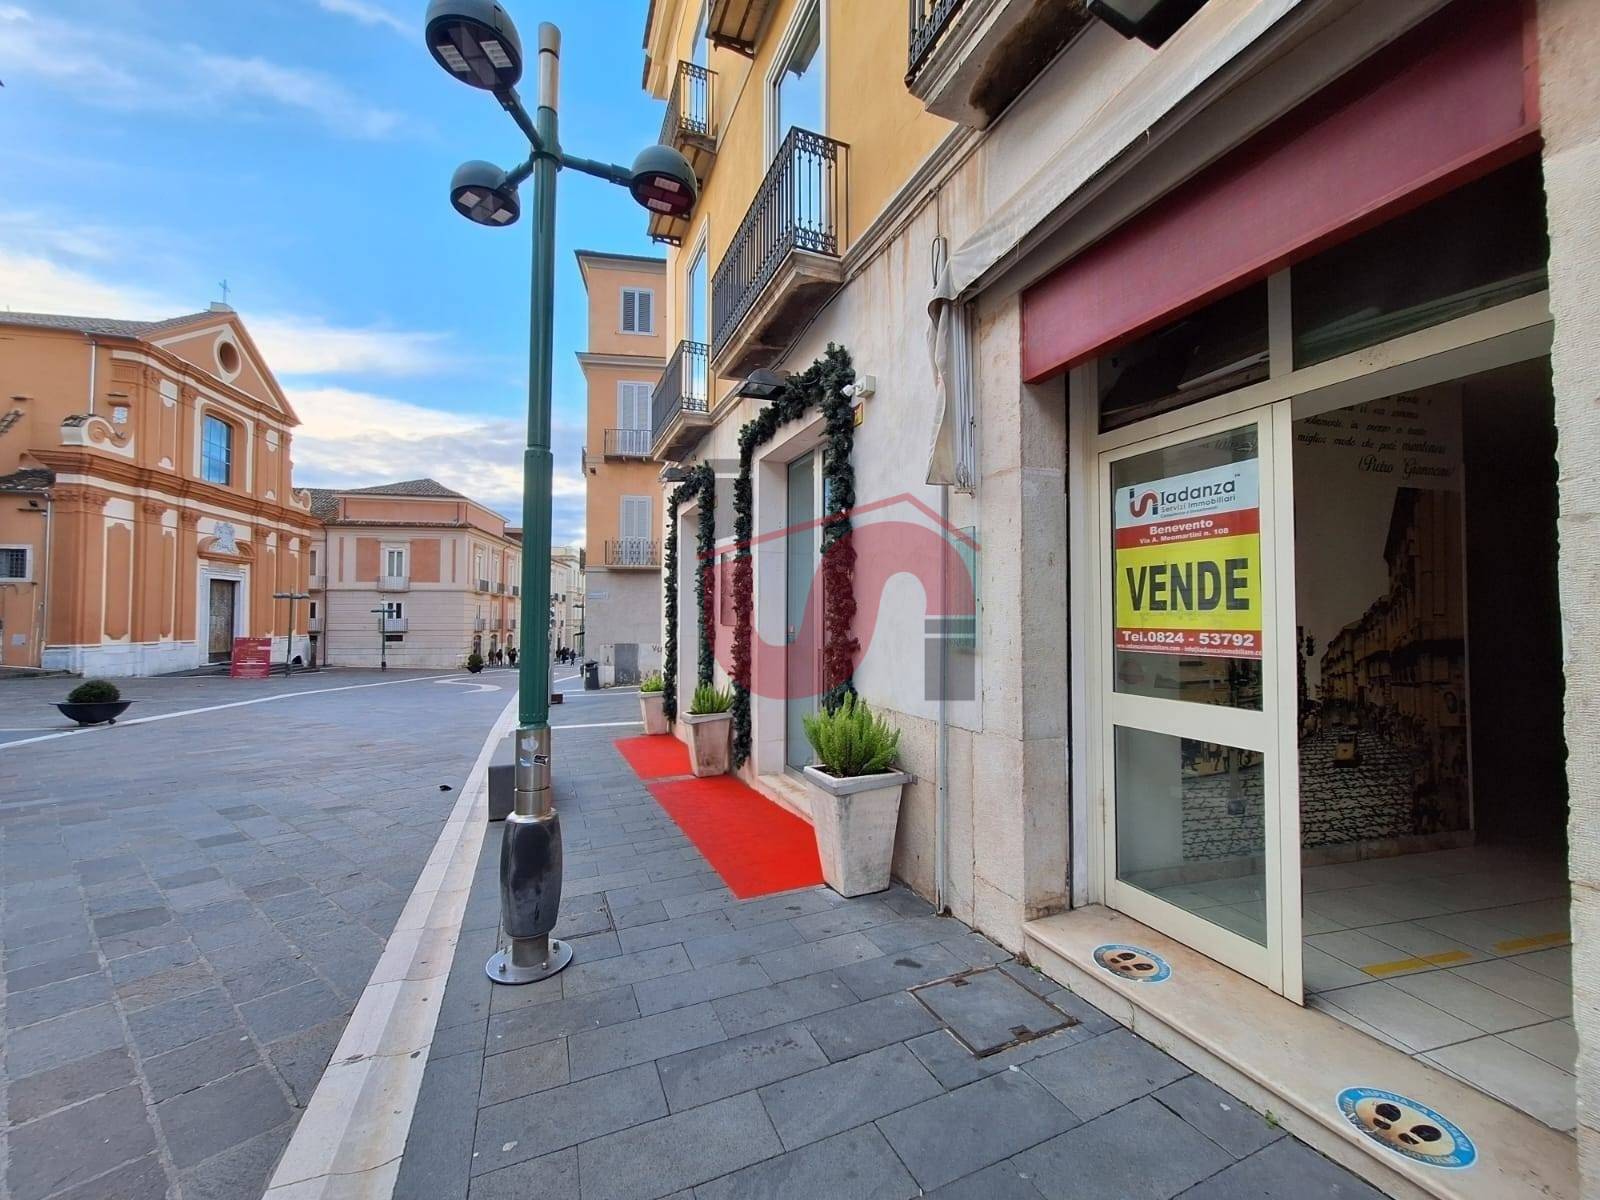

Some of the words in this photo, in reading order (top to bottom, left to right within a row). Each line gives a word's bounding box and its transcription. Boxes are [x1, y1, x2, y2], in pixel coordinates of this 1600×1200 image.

[1161, 480, 1236, 505] Iadanza
[1149, 519, 1213, 536] Benevento
[1139, 537, 1151, 545] Via
[1125, 558, 1249, 612] VENDE
[1199, 633, 1254, 647] 53792
